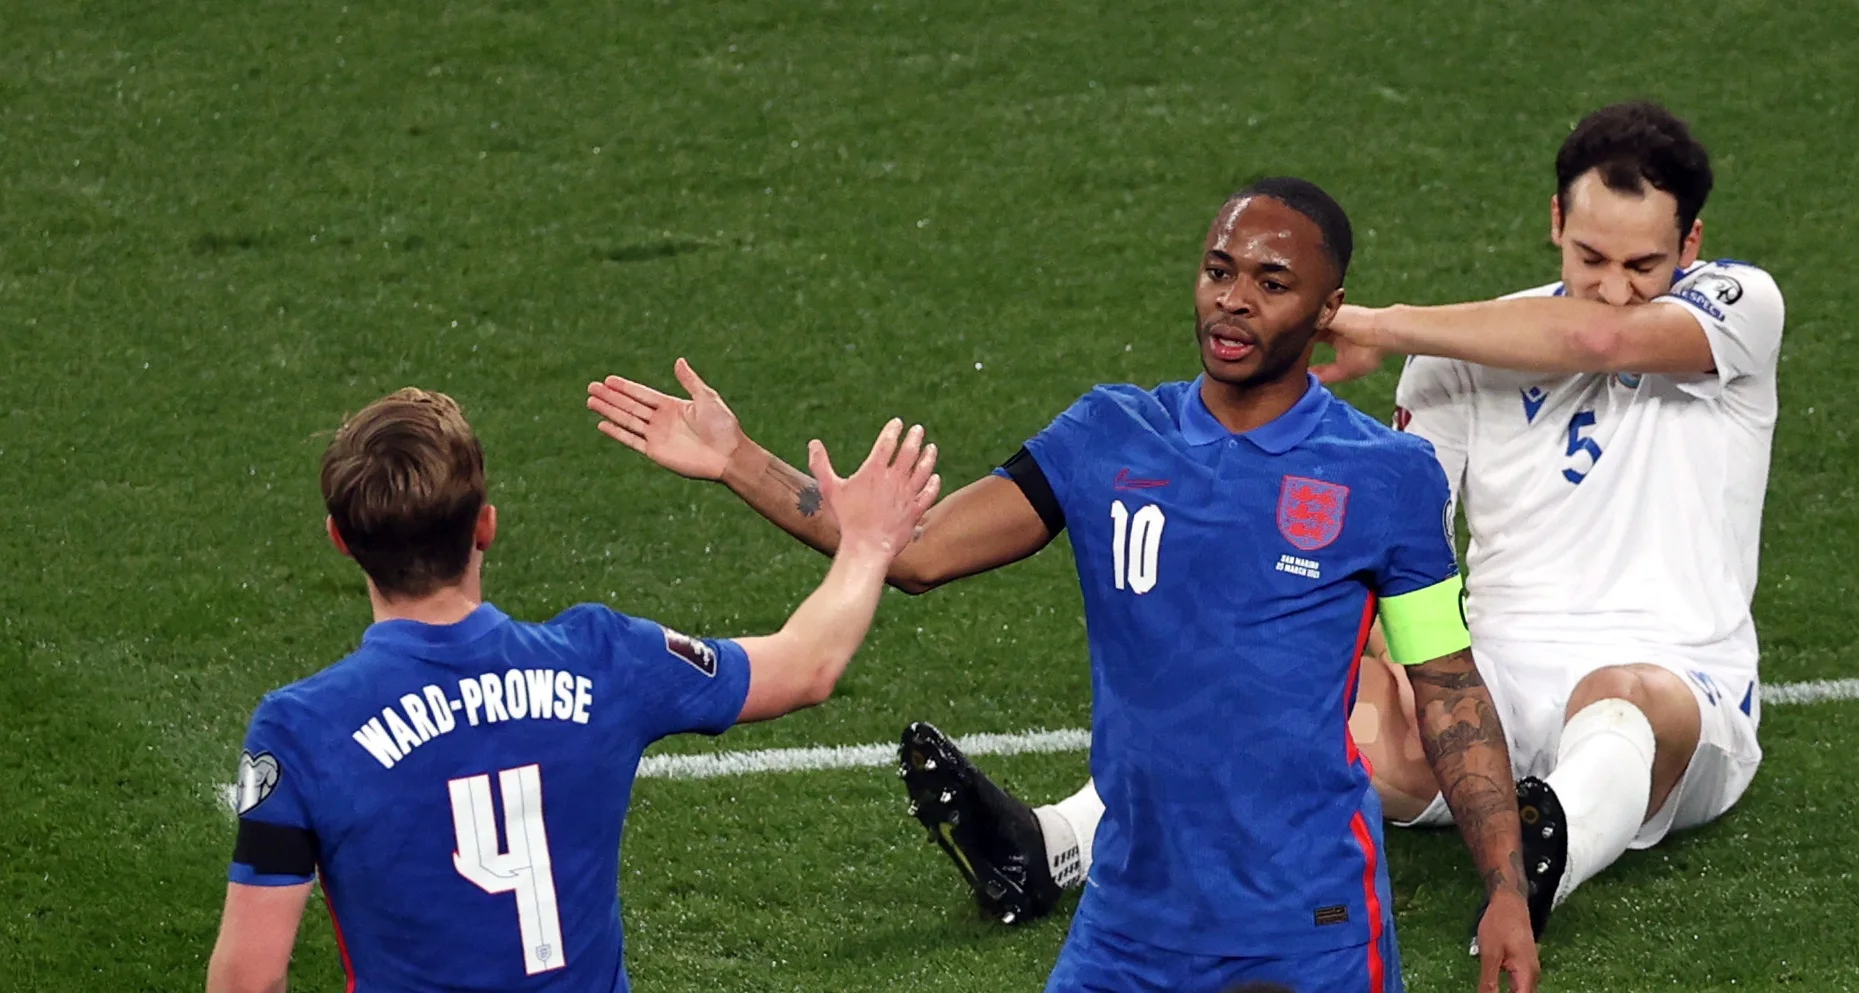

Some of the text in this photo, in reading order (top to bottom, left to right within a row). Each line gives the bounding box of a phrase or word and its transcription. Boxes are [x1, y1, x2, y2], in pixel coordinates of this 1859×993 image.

[1562, 410, 1603, 485] 5
[1110, 500, 1165, 594] 10
[352, 669, 593, 769] WARD-PROWSE
[448, 763, 566, 975] 4
